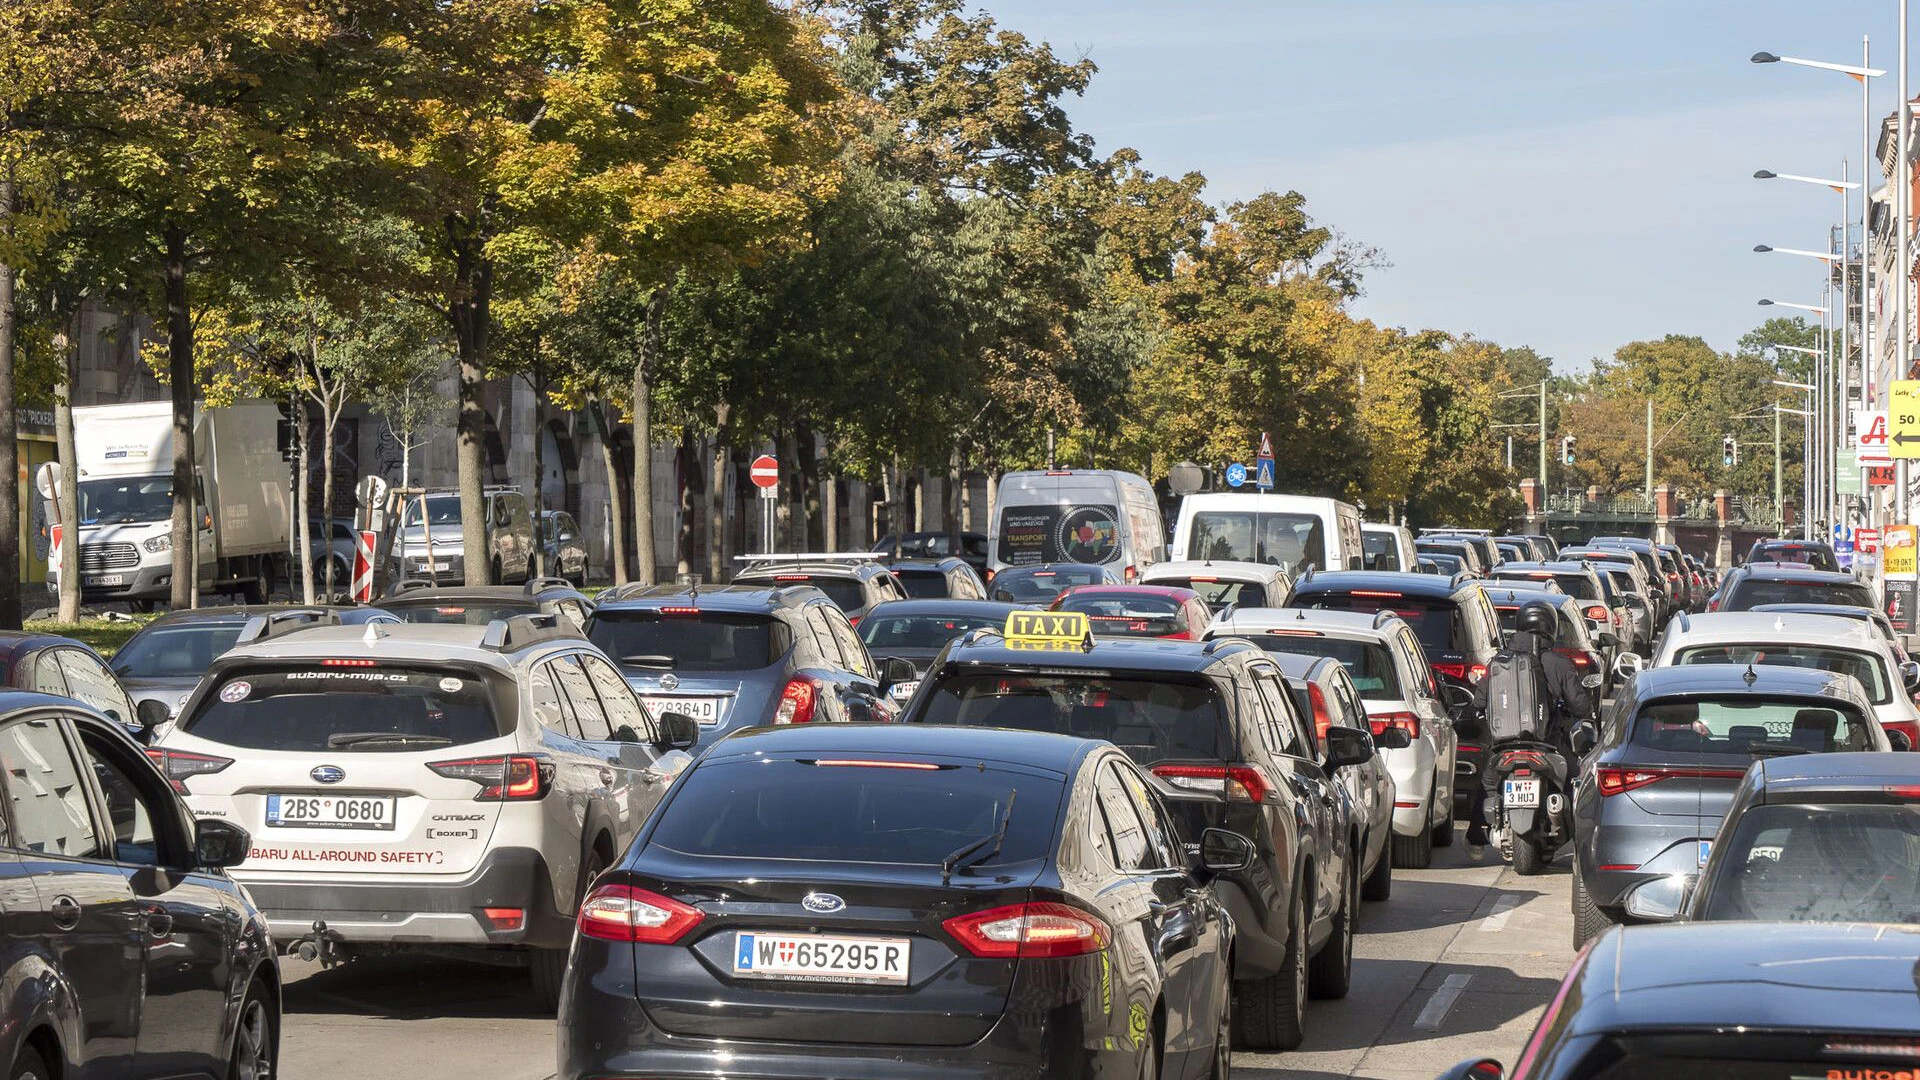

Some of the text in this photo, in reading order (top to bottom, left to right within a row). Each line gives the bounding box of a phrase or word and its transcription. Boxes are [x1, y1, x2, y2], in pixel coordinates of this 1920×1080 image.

[1899, 415, 1915, 424] 50
[1018, 617, 1076, 635] TAXI
[286, 672, 408, 681] subaru-mija.cz
[657, 702, 711, 716] 29364 D
[1515, 783, 1522, 792] W
[1510, 793, 1534, 803] 3 HUJ
[284, 799, 320, 819] 2BS
[335, 800, 384, 820] 0680
[292, 850, 377, 862] ALL-AROUND
[381, 851, 434, 863] SAFETY
[810, 897, 836, 908] Ford
[741, 940, 900, 972] A W 65295 R
